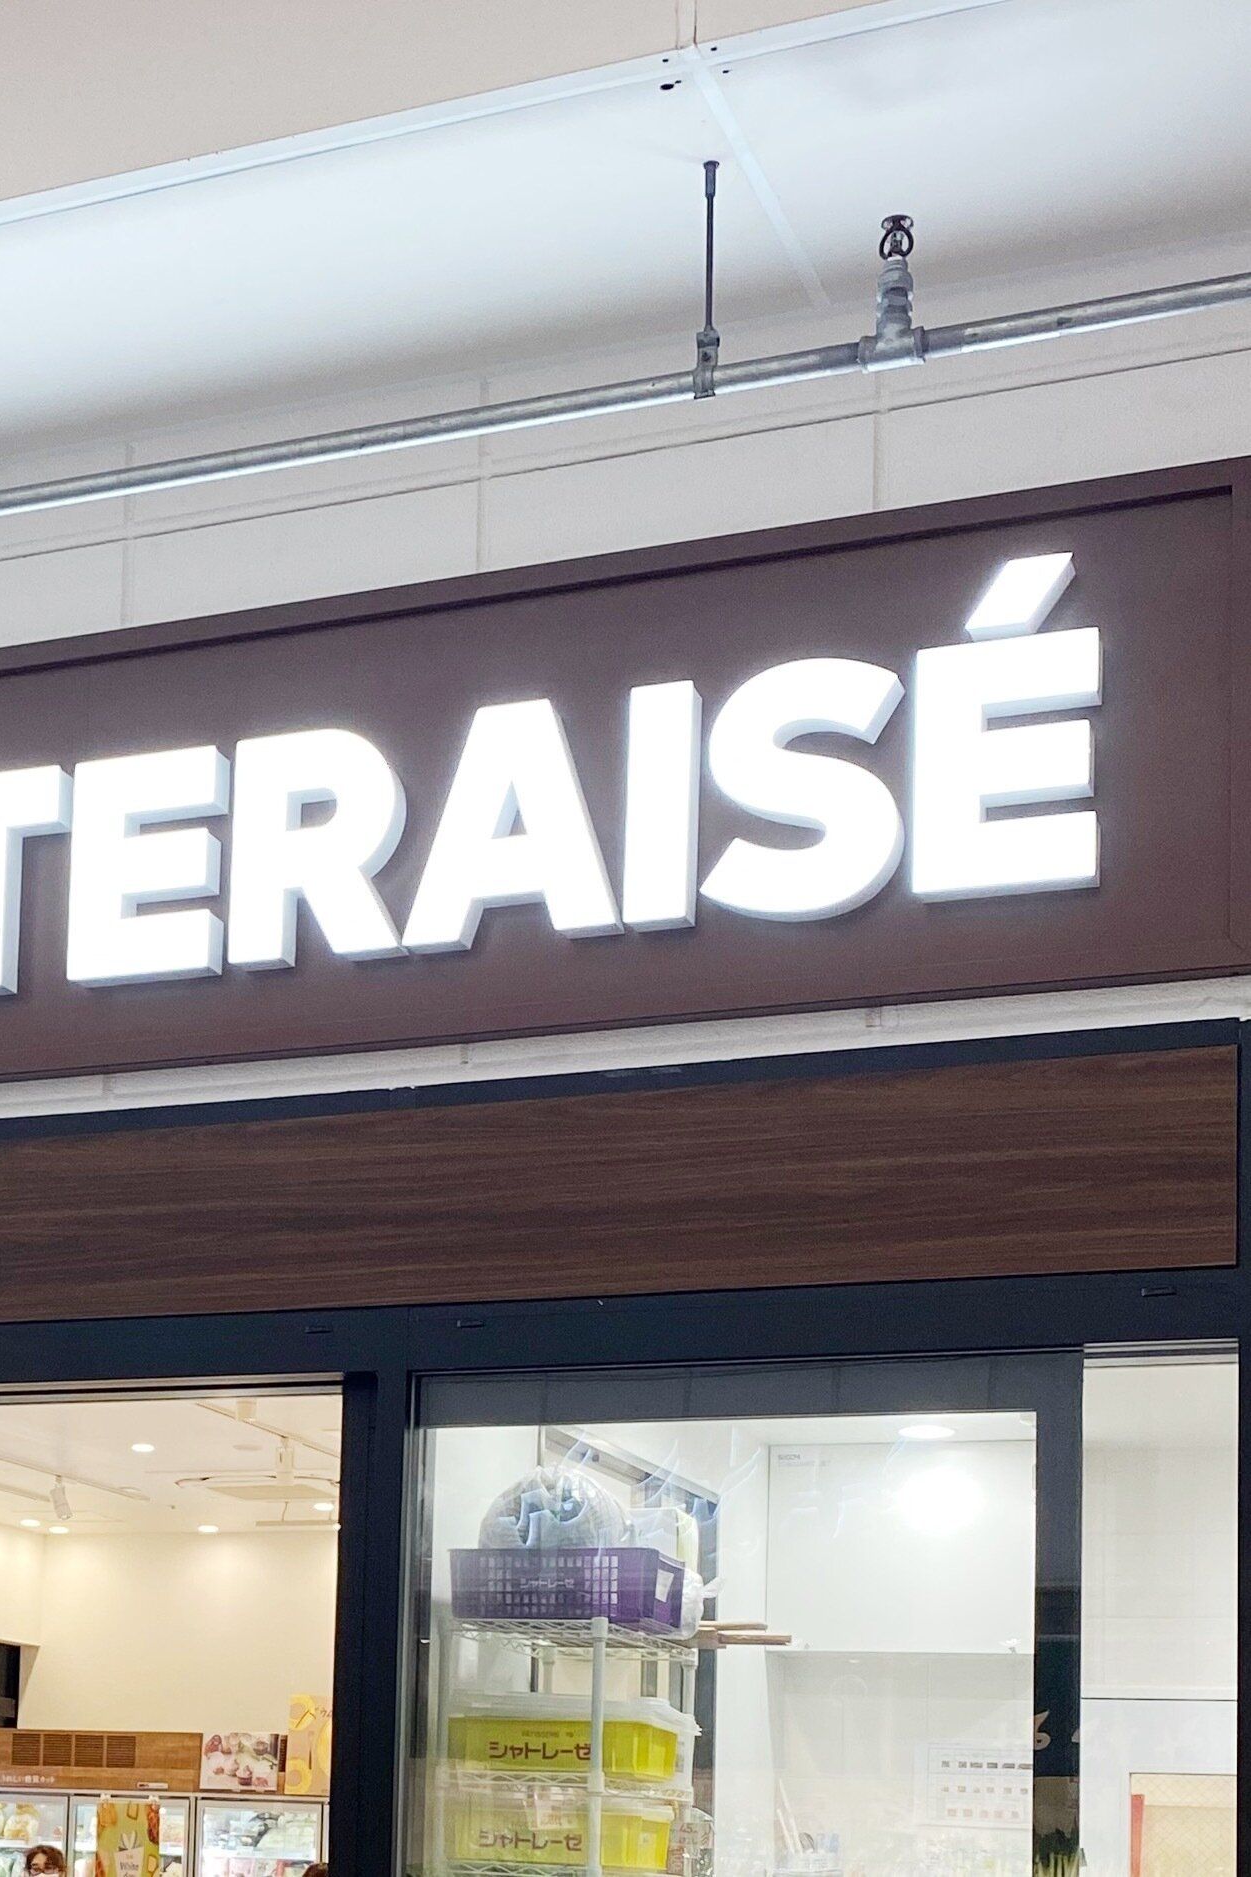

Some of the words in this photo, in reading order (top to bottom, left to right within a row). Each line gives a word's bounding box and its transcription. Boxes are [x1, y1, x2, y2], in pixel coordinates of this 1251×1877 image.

[488, 1741, 591, 1760] シャトレーゼ
[479, 1829, 583, 1851] シャトレーゼ
